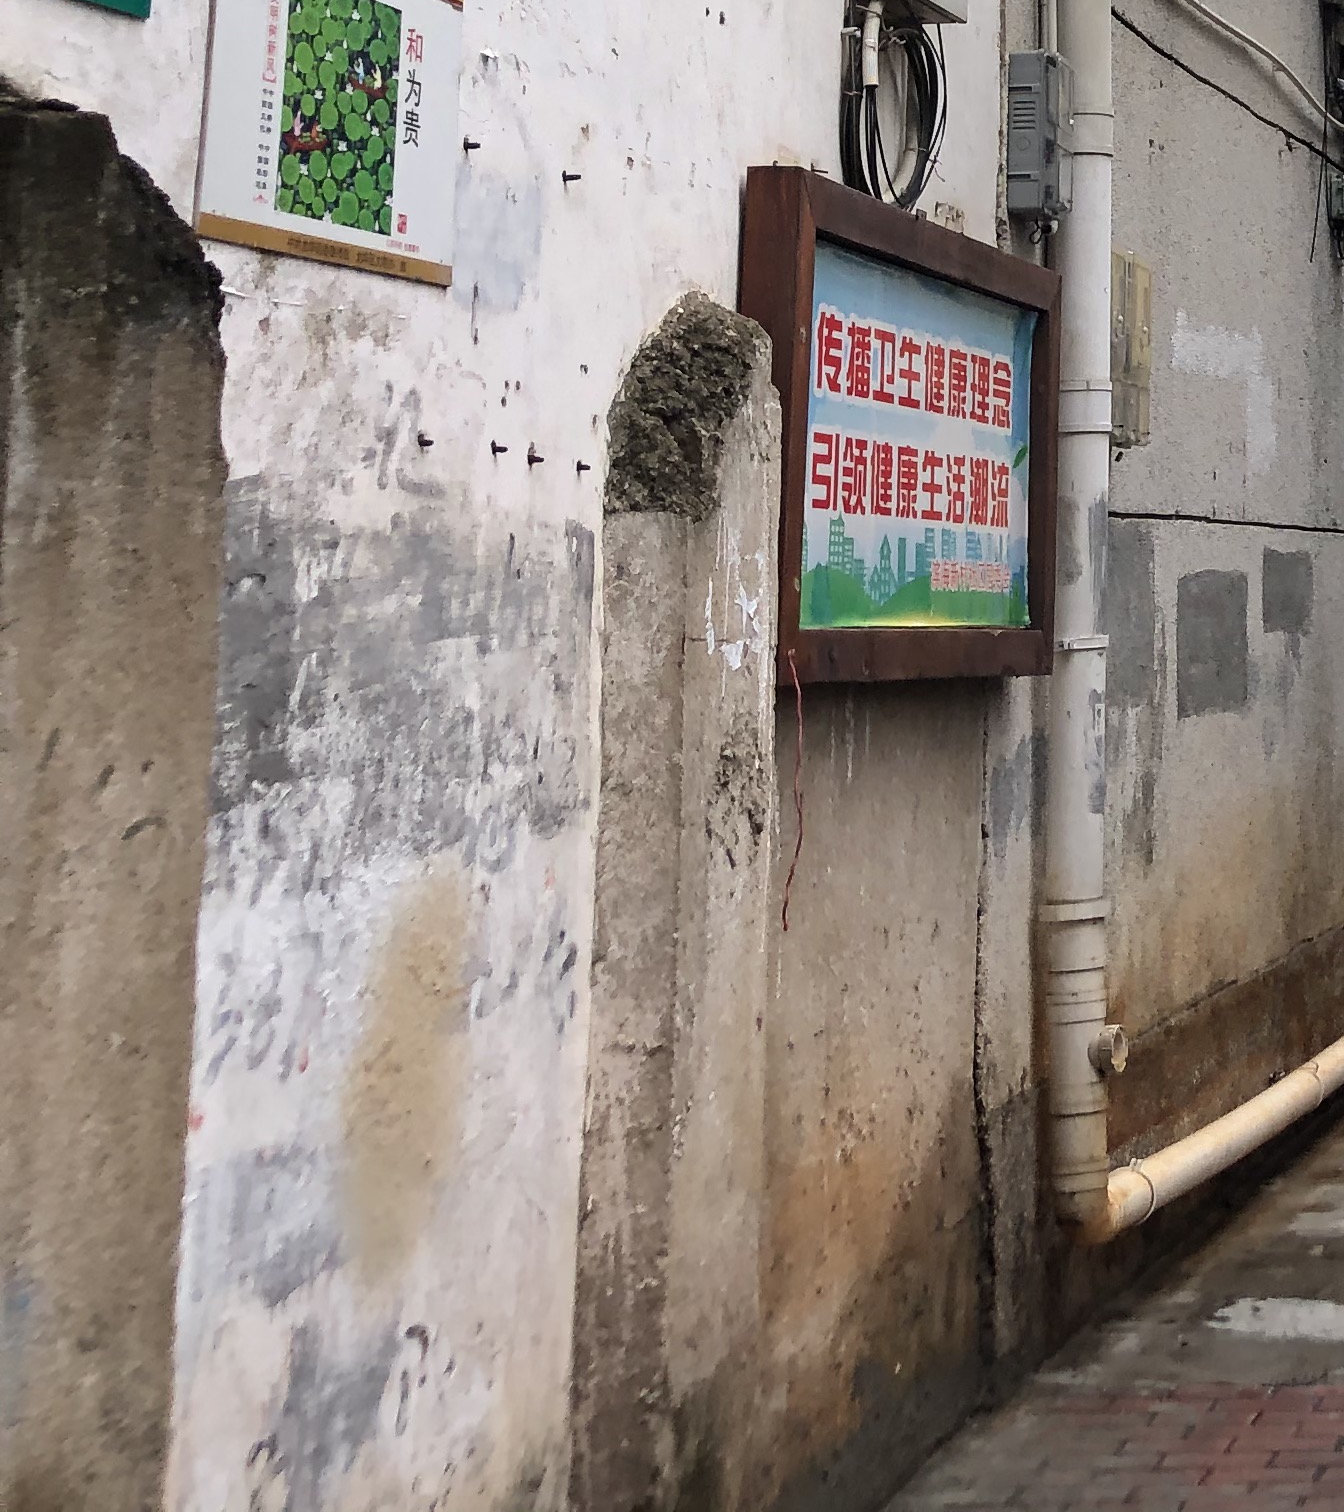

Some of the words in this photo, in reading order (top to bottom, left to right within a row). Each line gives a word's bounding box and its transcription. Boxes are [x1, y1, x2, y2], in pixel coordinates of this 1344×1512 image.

[402, 28, 423, 147] 和为贵
[816, 311, 1012, 428] 传播卫生健康理念
[811, 431, 1009, 528] 引领健康生活潮流
